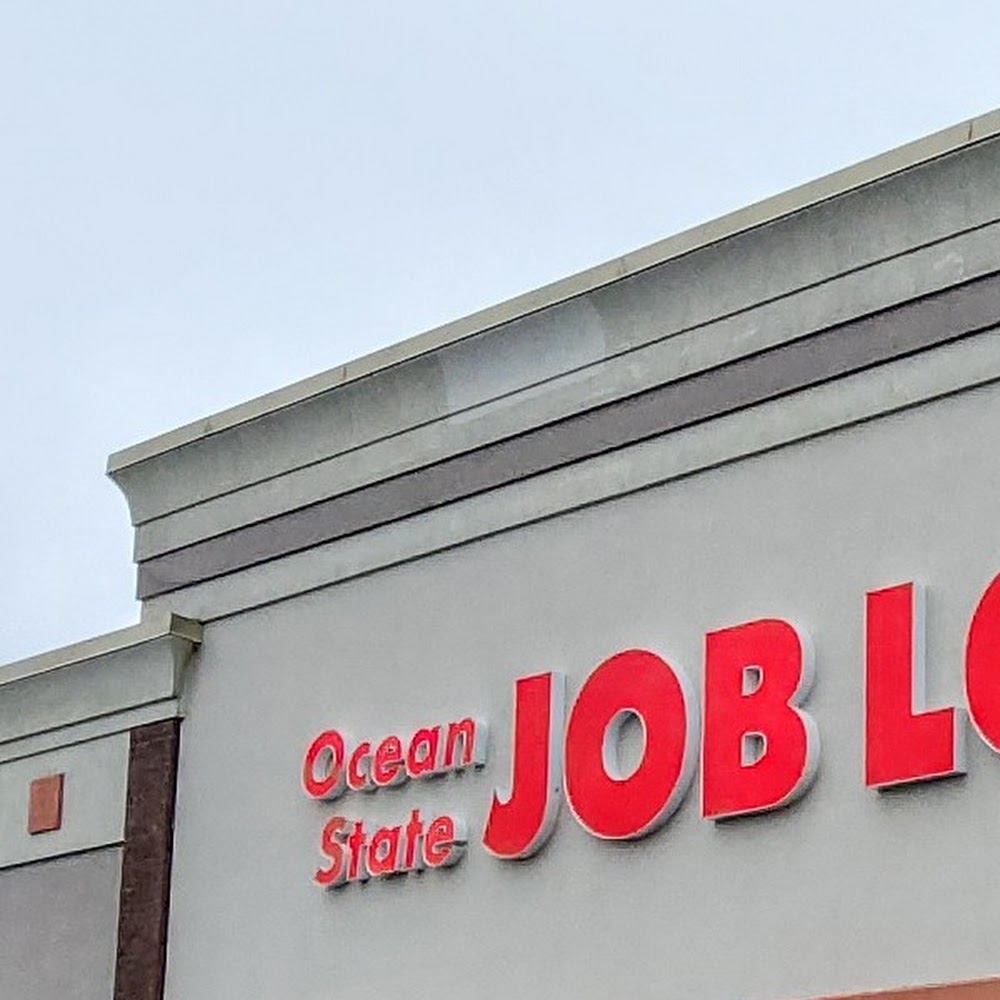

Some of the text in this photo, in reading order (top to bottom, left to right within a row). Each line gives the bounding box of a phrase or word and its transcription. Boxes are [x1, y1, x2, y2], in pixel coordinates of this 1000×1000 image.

[302, 717, 477, 799] Ocean
[483, 617, 814, 858] JOB
[314, 808, 457, 885] State
